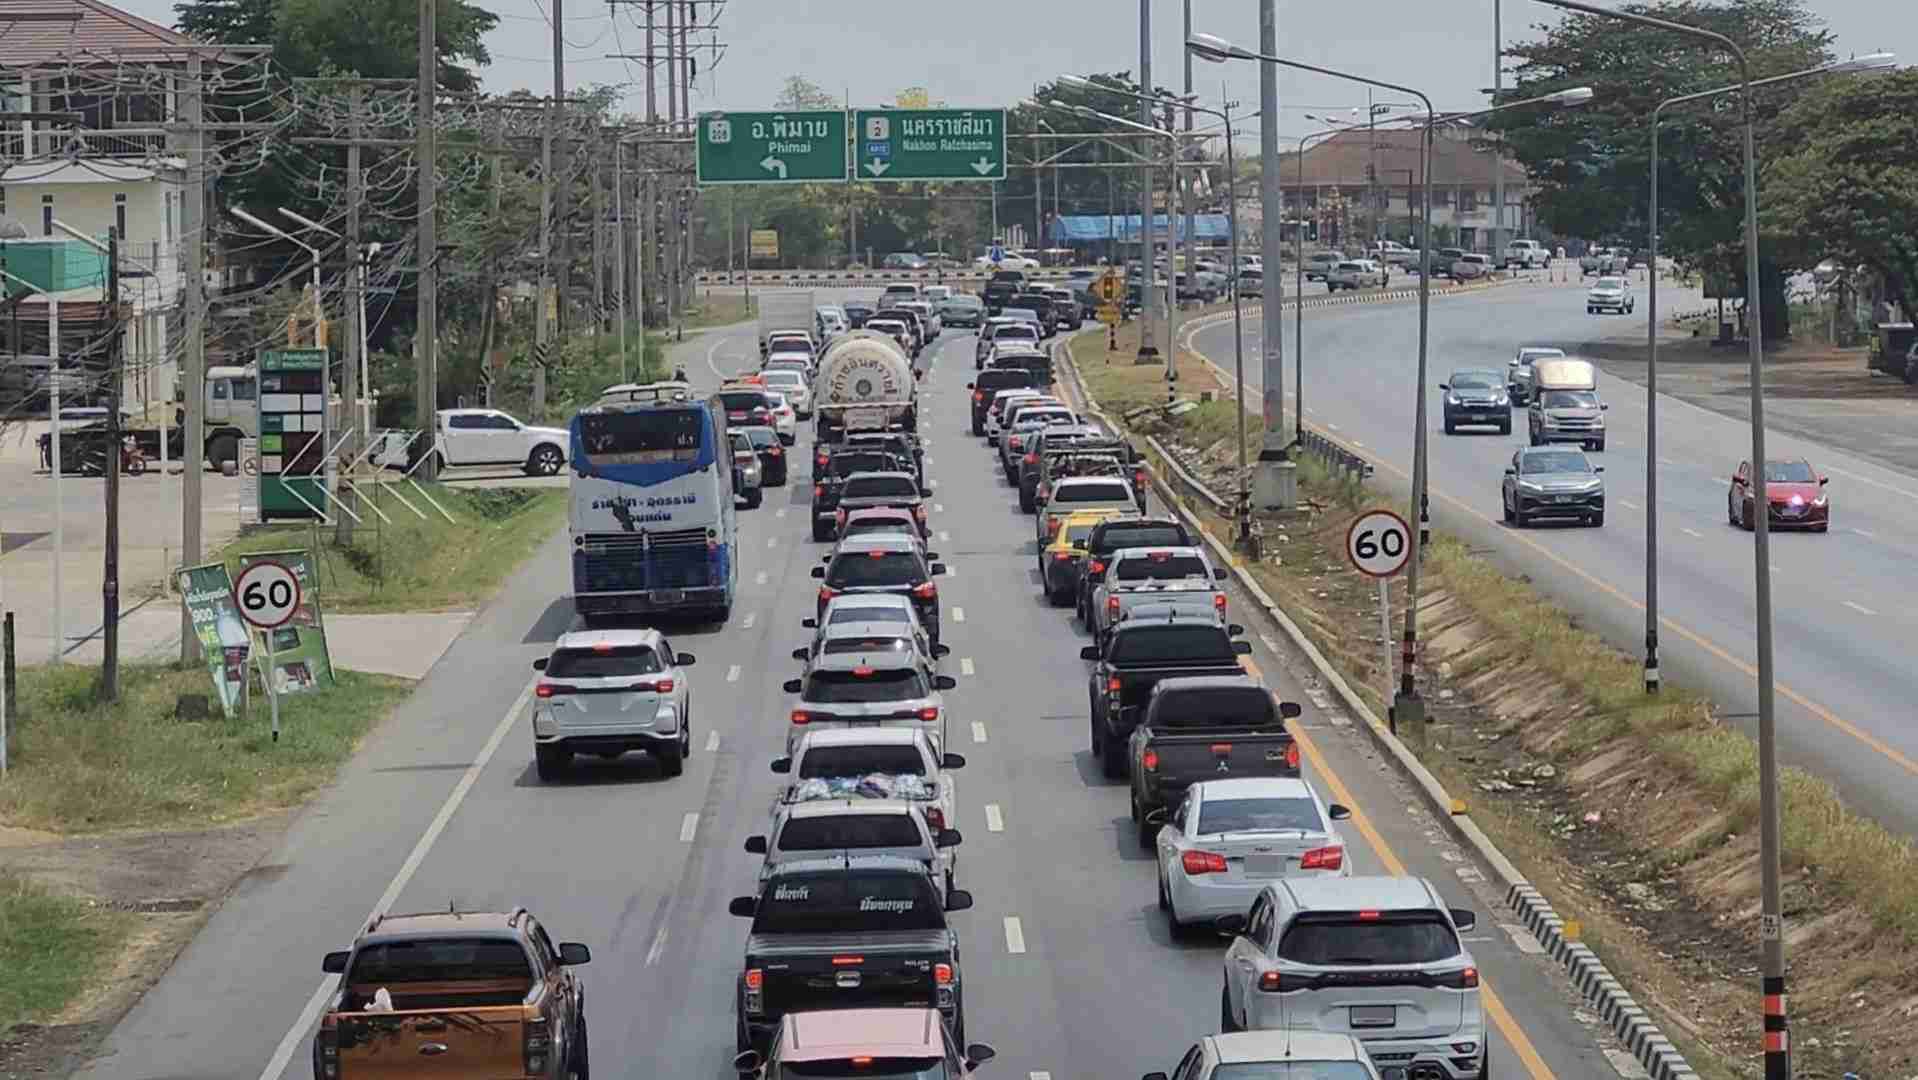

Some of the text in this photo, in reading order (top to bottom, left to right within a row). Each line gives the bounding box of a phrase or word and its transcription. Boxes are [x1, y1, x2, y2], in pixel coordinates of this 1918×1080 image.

[752, 115, 828, 138] อ.พิมาย
[902, 112, 993, 136] นครราชสีมา
[768, 141, 811, 153] Phimai
[1355, 528, 1404, 559] 60
[243, 579, 292, 610] 60
